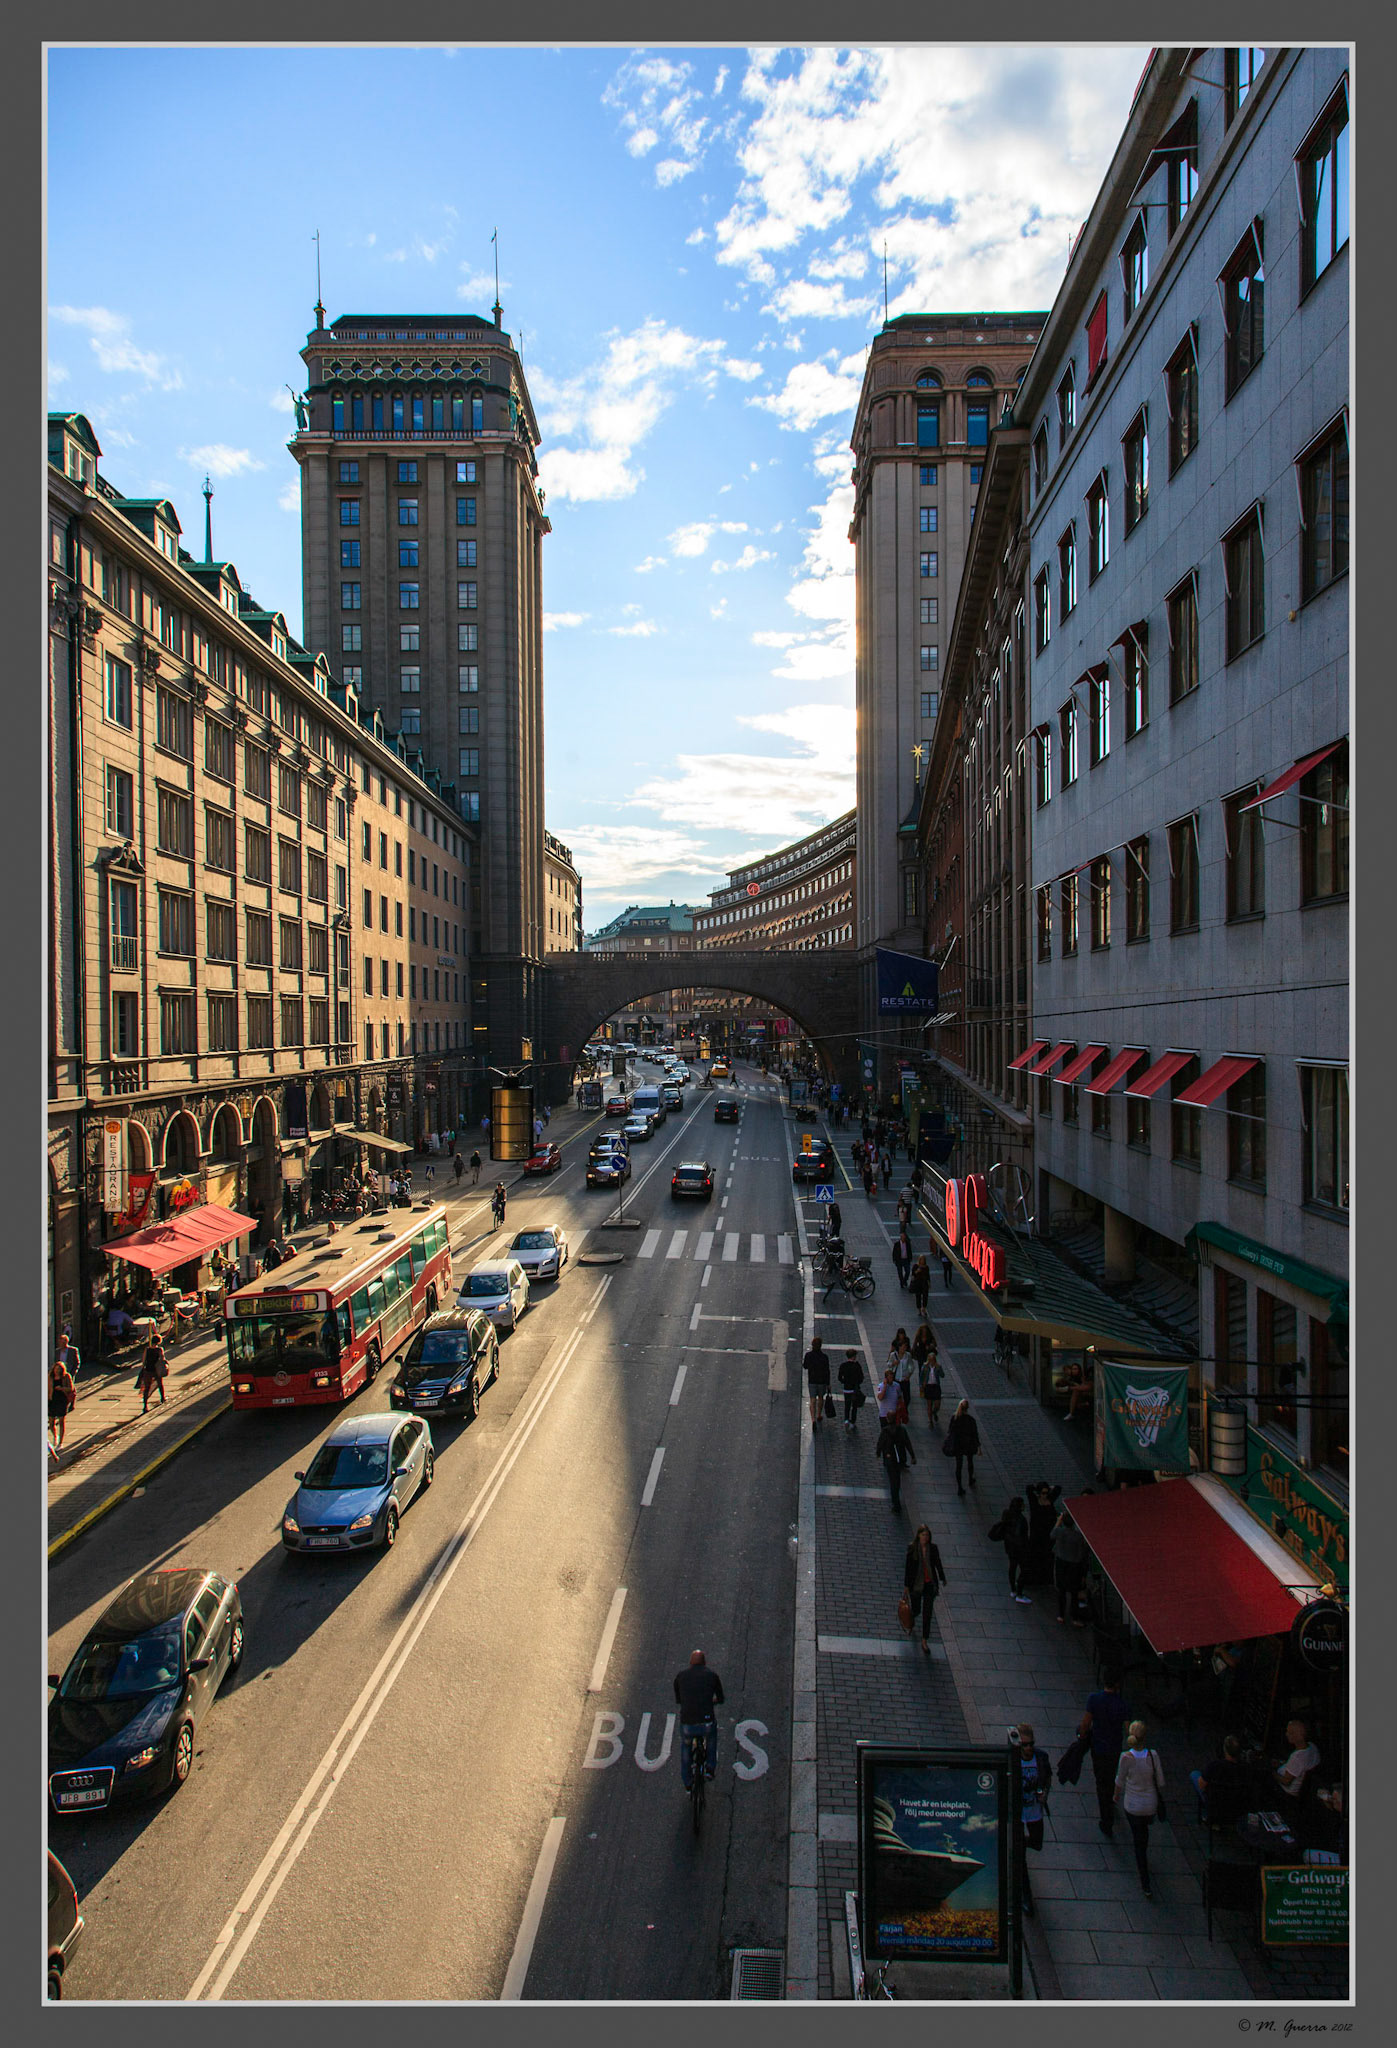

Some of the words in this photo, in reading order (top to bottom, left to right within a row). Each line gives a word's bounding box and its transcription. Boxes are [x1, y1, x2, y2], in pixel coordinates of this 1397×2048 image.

[881, 997, 935, 1006] RESTATE
[109, 1135, 118, 1203] RESTAURANG
[1260, 1452, 1346, 1563] Galway's
[582, 1711, 771, 1781] BUS
[85, 1790, 103, 1800] 891
[899, 1798, 922, 1808] Havet
[922, 1799, 930, 1808] är
[940, 1800, 971, 1810] lekplats,
[904, 1808, 918, 1818] följ
[918, 1809, 935, 1817] med
[935, 1809, 966, 1818] ombord!
[879, 1925, 903, 1933] Färjan
[906, 1936, 935, 1946] måndag
[936, 1937, 945, 1945] 20
[945, 1938, 971, 1947] augusti
[972, 1938, 993, 1946] 20.00
